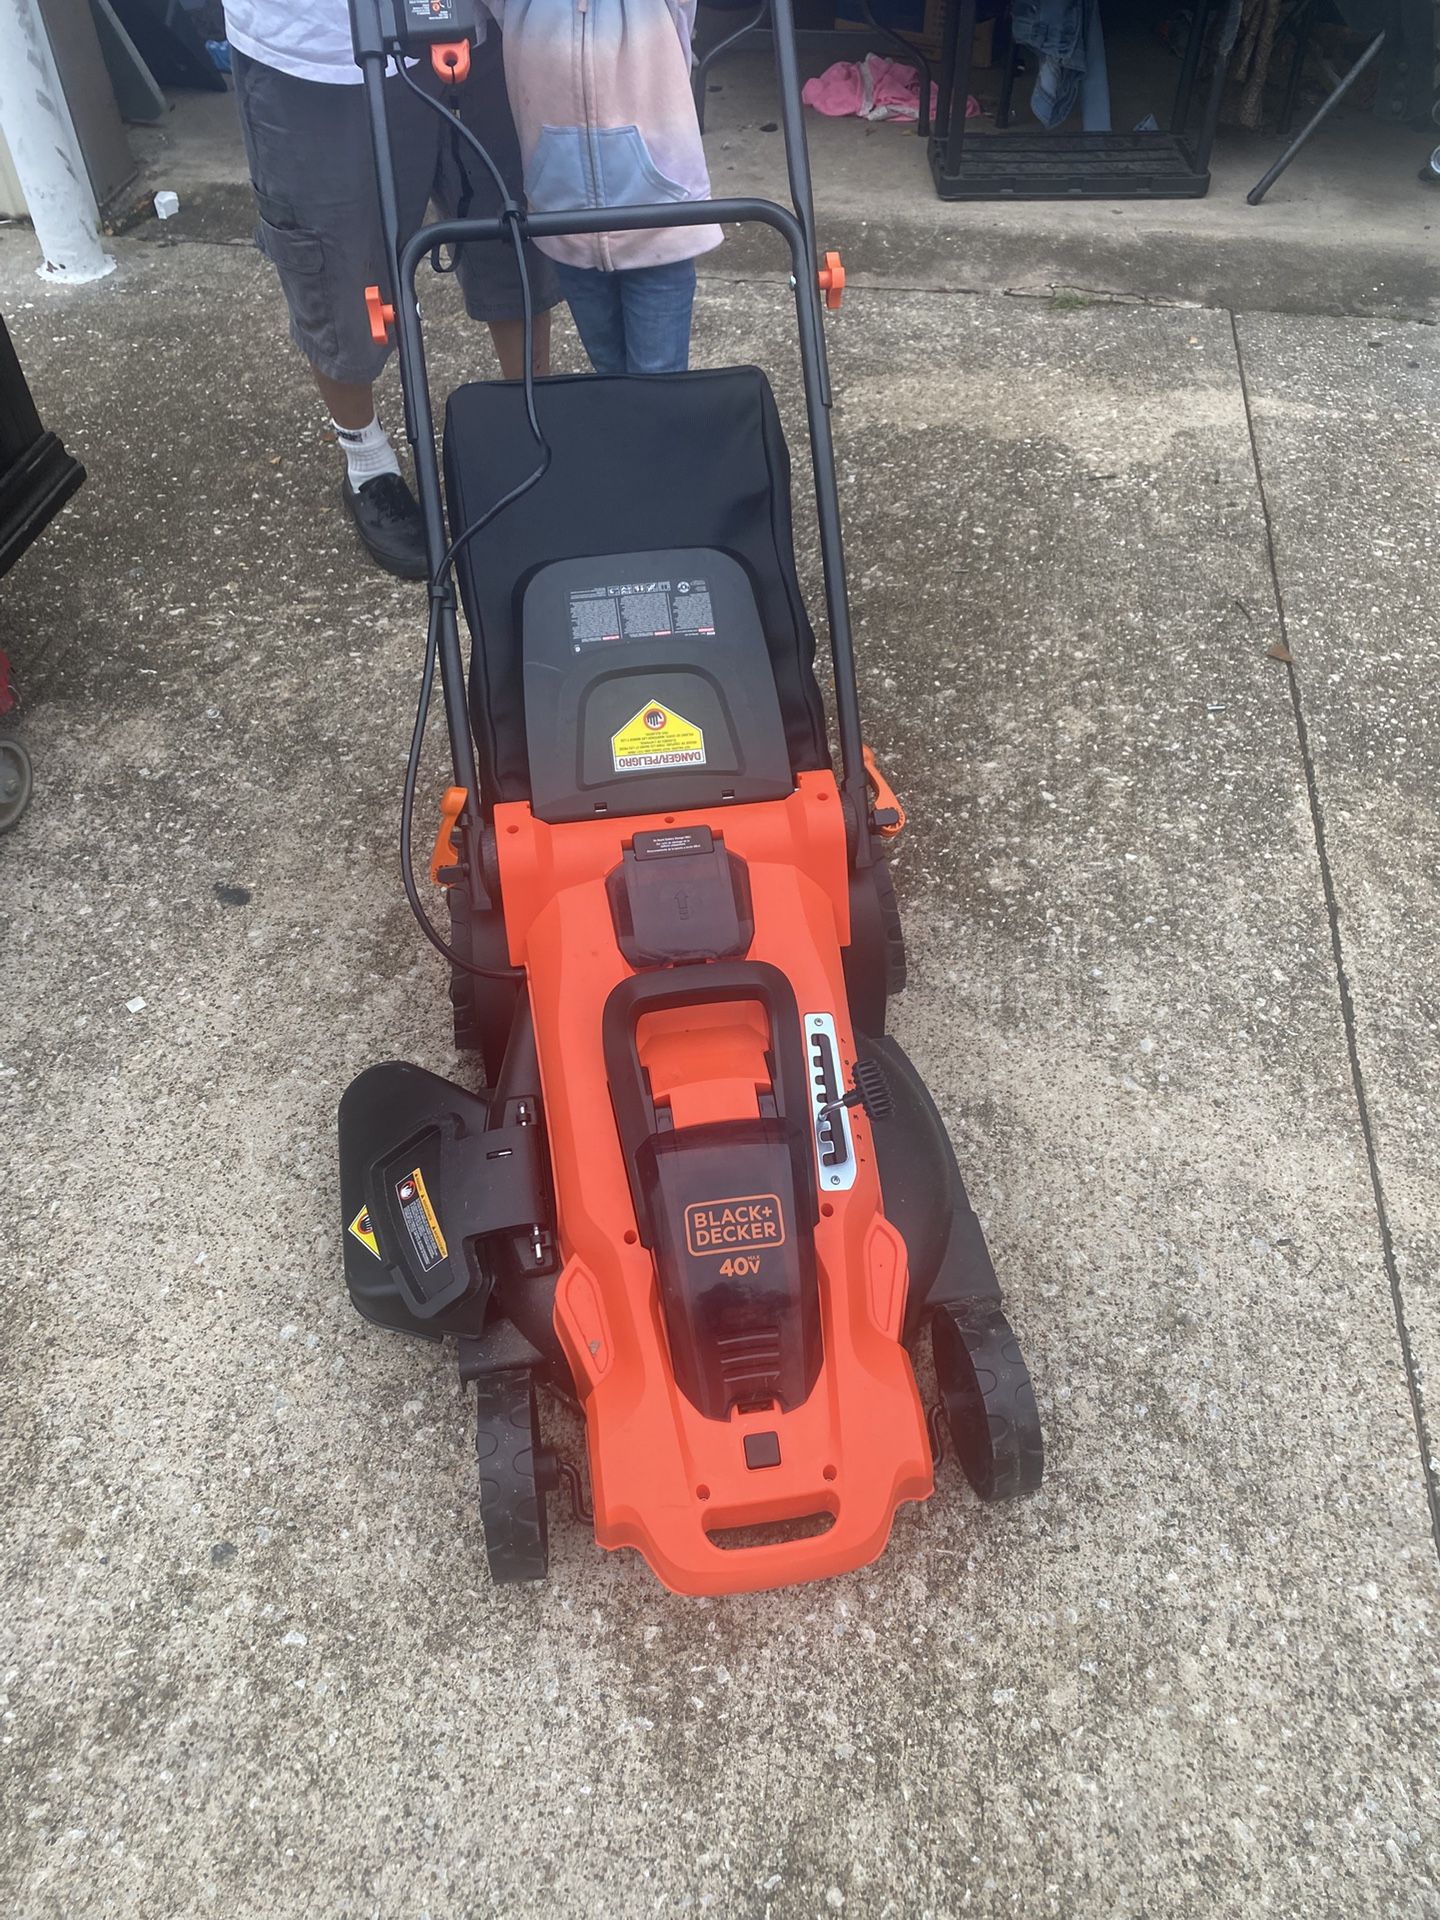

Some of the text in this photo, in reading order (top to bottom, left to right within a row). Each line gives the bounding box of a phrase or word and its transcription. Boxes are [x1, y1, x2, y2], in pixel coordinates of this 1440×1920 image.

[618, 752, 701, 768] DANGER/PELIGRO
[693, 1204, 773, 1229] BLACK+
[695, 1221, 777, 1247] DECKER
